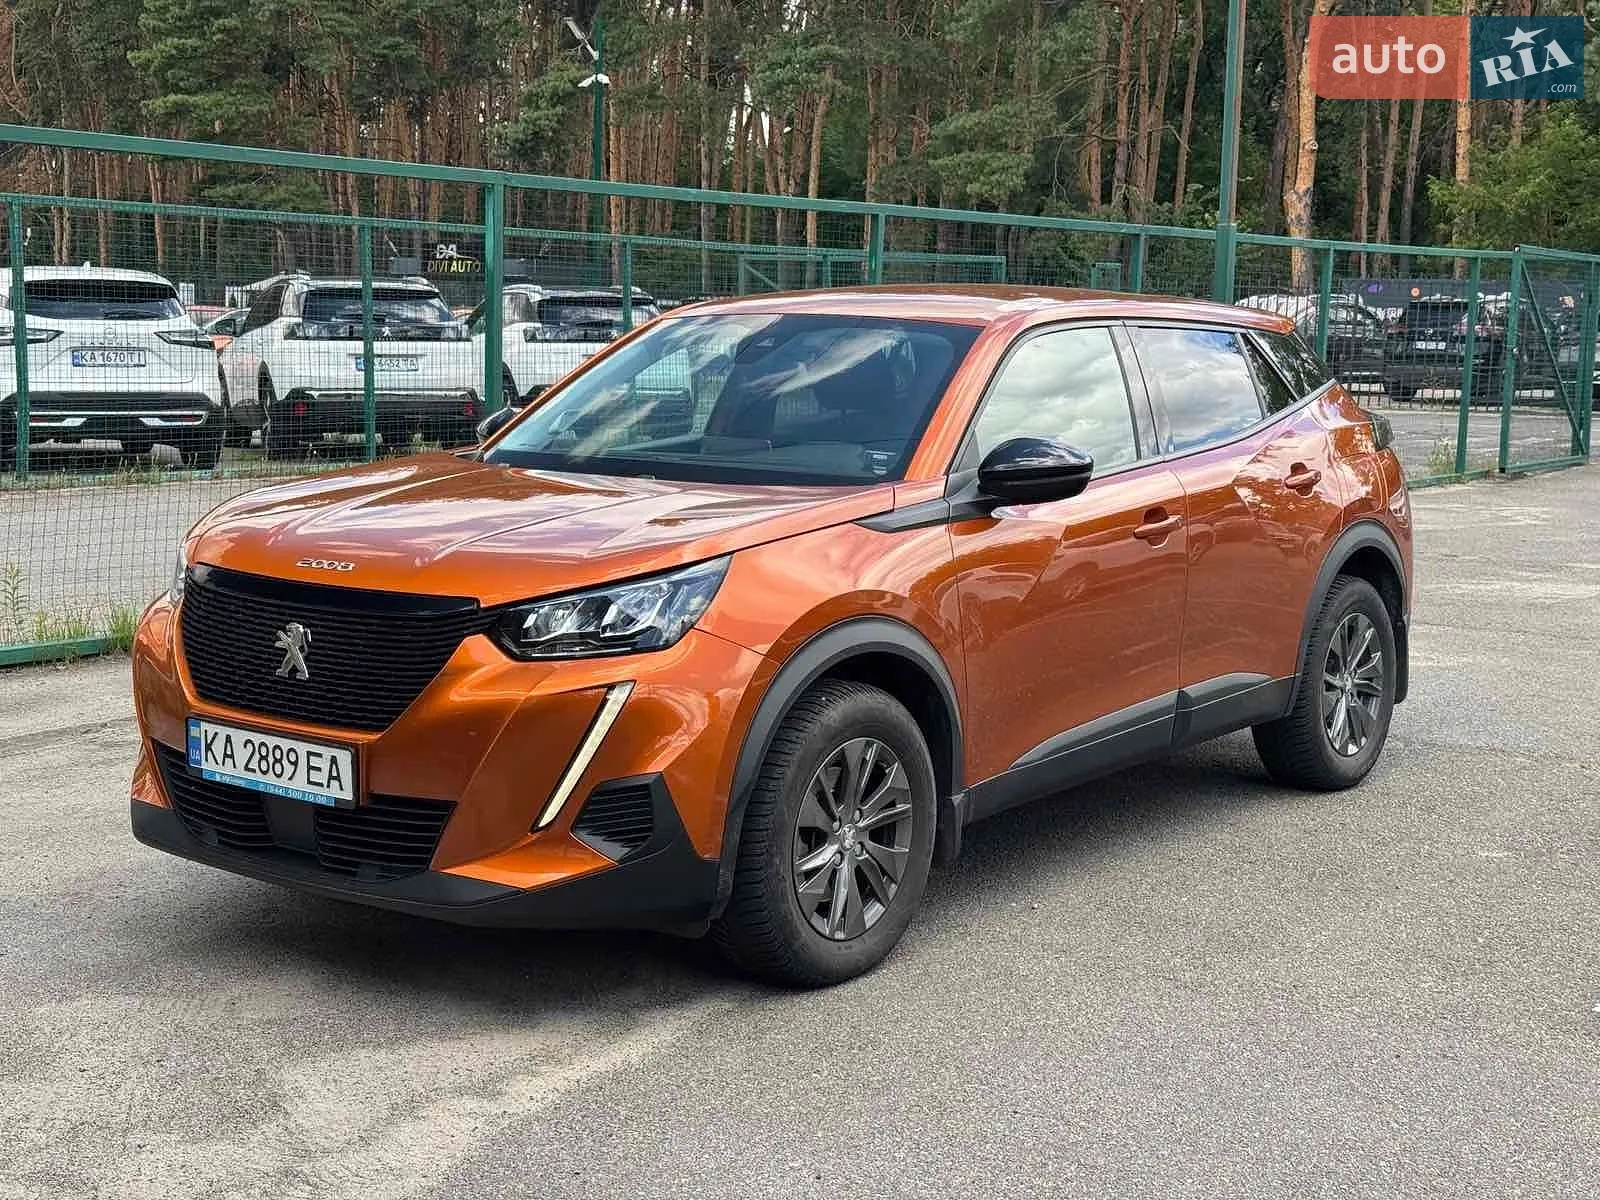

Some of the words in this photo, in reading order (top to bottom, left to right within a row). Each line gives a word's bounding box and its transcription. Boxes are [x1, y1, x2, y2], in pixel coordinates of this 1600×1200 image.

[450, 260, 480, 273] AUTO
[80, 351, 96, 362] KA
[100, 351, 126, 362] 1670
[296, 558, 355, 571] 2008
[190, 748, 201, 762] UA
[204, 729, 237, 769] KA
[243, 738, 300, 781] 2889
[306, 750, 345, 791] EA
